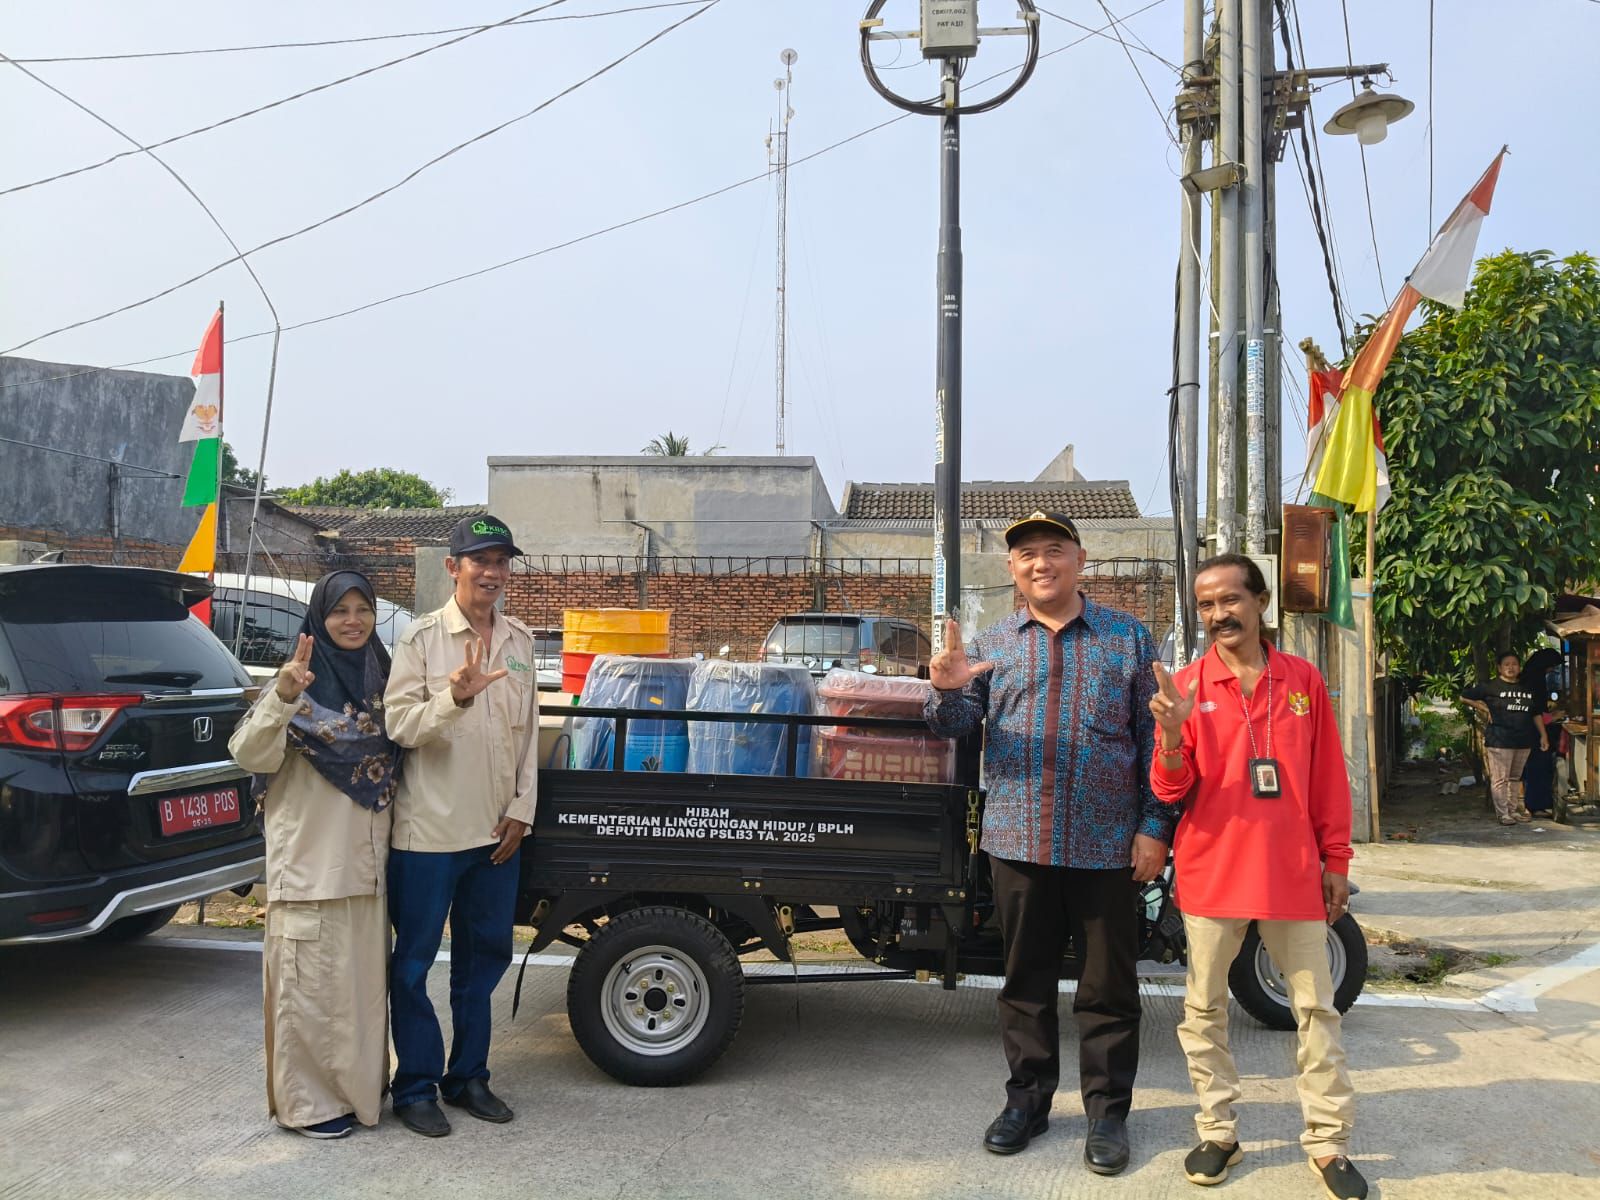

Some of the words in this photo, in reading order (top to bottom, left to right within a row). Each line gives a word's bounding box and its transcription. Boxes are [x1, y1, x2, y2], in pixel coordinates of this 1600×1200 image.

[164, 801, 174, 822] B
[180, 794, 208, 819] 1438
[686, 807, 730, 819] HIBAH
[558, 813, 661, 827] KEMENTERIAN
[664, 816, 759, 831] LINGKUNGAN
[763, 820, 807, 832] HIDUP
[817, 823, 855, 835] BPLH
[596, 825, 649, 837] DEPUTI
[652, 827, 706, 839] BIDANG
[709, 828, 753, 840] PSLB3
[757, 830, 779, 841] TA.
[783, 832, 816, 844] 2025
